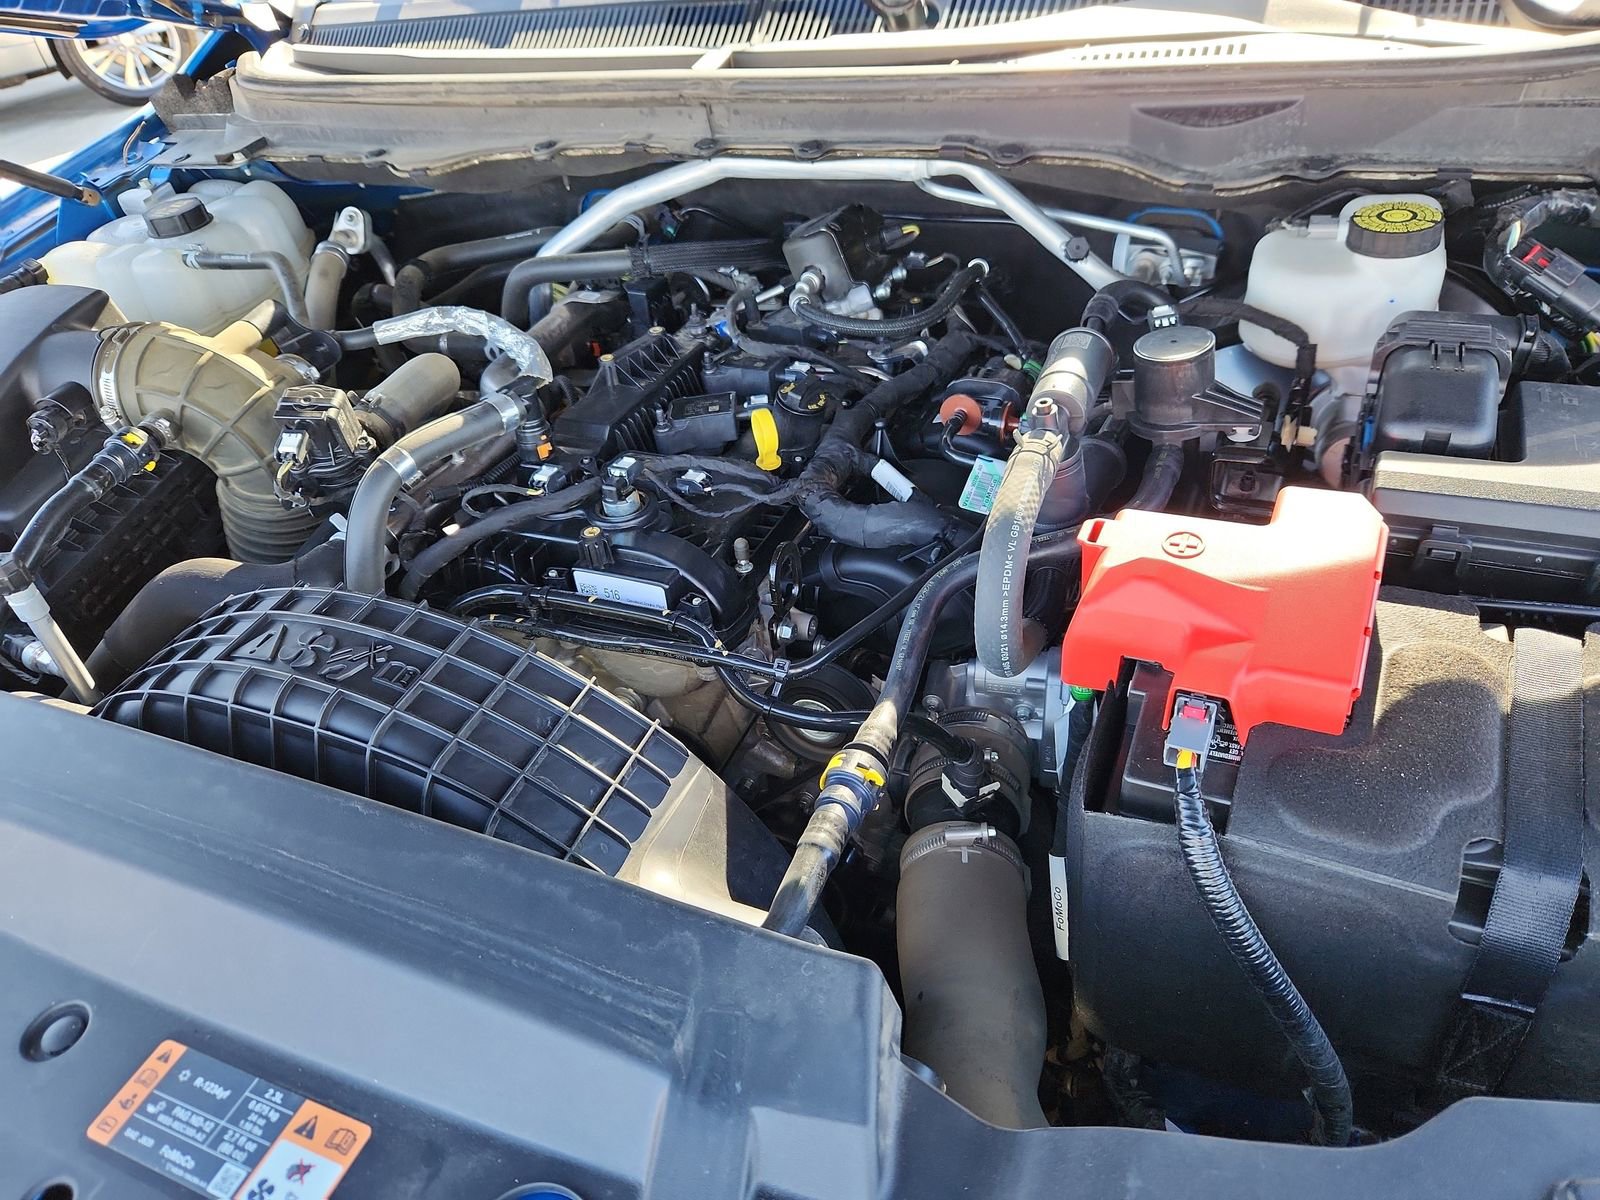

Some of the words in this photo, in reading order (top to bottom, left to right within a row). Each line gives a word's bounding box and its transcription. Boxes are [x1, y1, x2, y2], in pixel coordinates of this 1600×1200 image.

[1002, 554, 1014, 597] >EPDM<
[603, 588, 621, 600] 516
[1001, 644, 1009, 661] 03/21
[1054, 886, 1065, 931] FoMoCo
